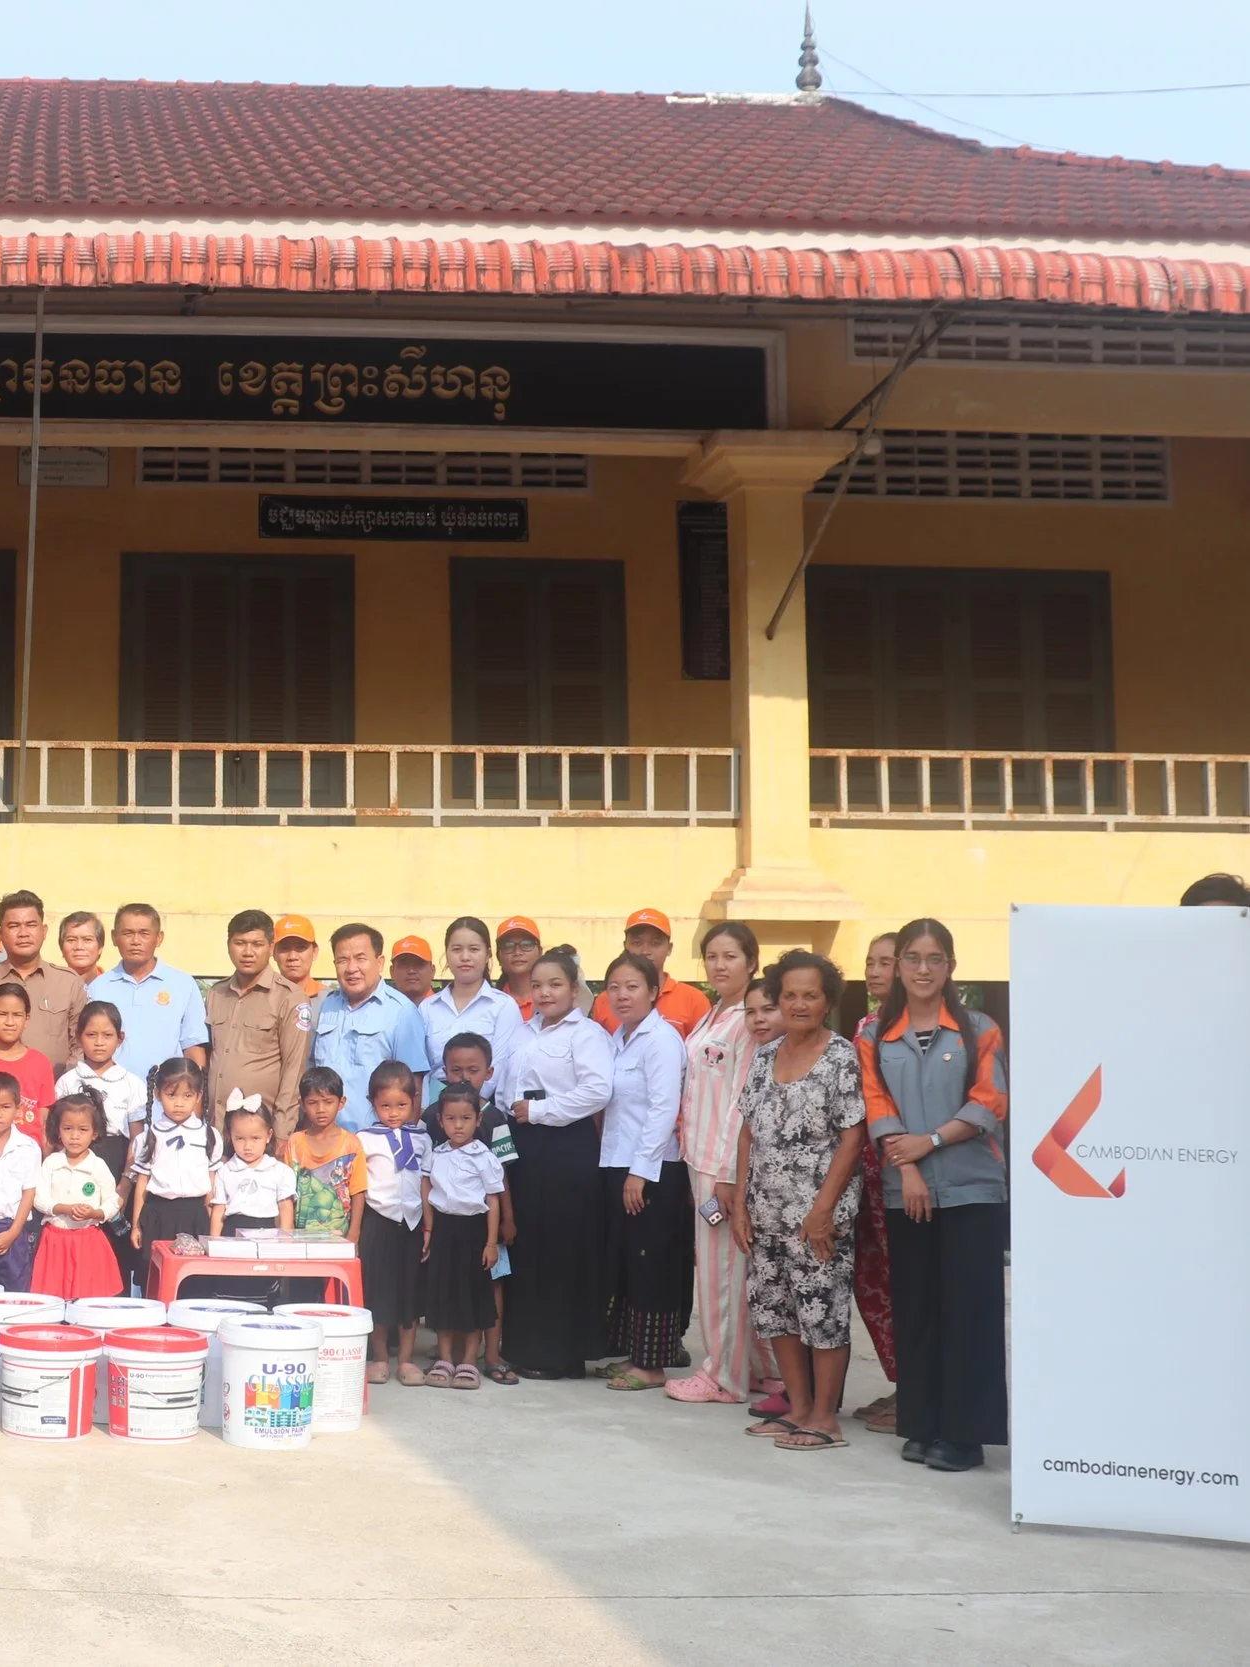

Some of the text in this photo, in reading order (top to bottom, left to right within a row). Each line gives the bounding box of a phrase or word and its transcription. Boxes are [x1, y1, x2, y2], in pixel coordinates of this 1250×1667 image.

[1075, 1144, 1239, 1164] CAMBODIAN ENERGY
[319, 1348, 335, 1357] -90
[261, 1362, 307, 1375] U-90
[248, 1372, 315, 1393] CLASSIC
[254, 1427, 290, 1435] EMULSION
[1042, 1458, 1240, 1487] cambodianenergy.com
